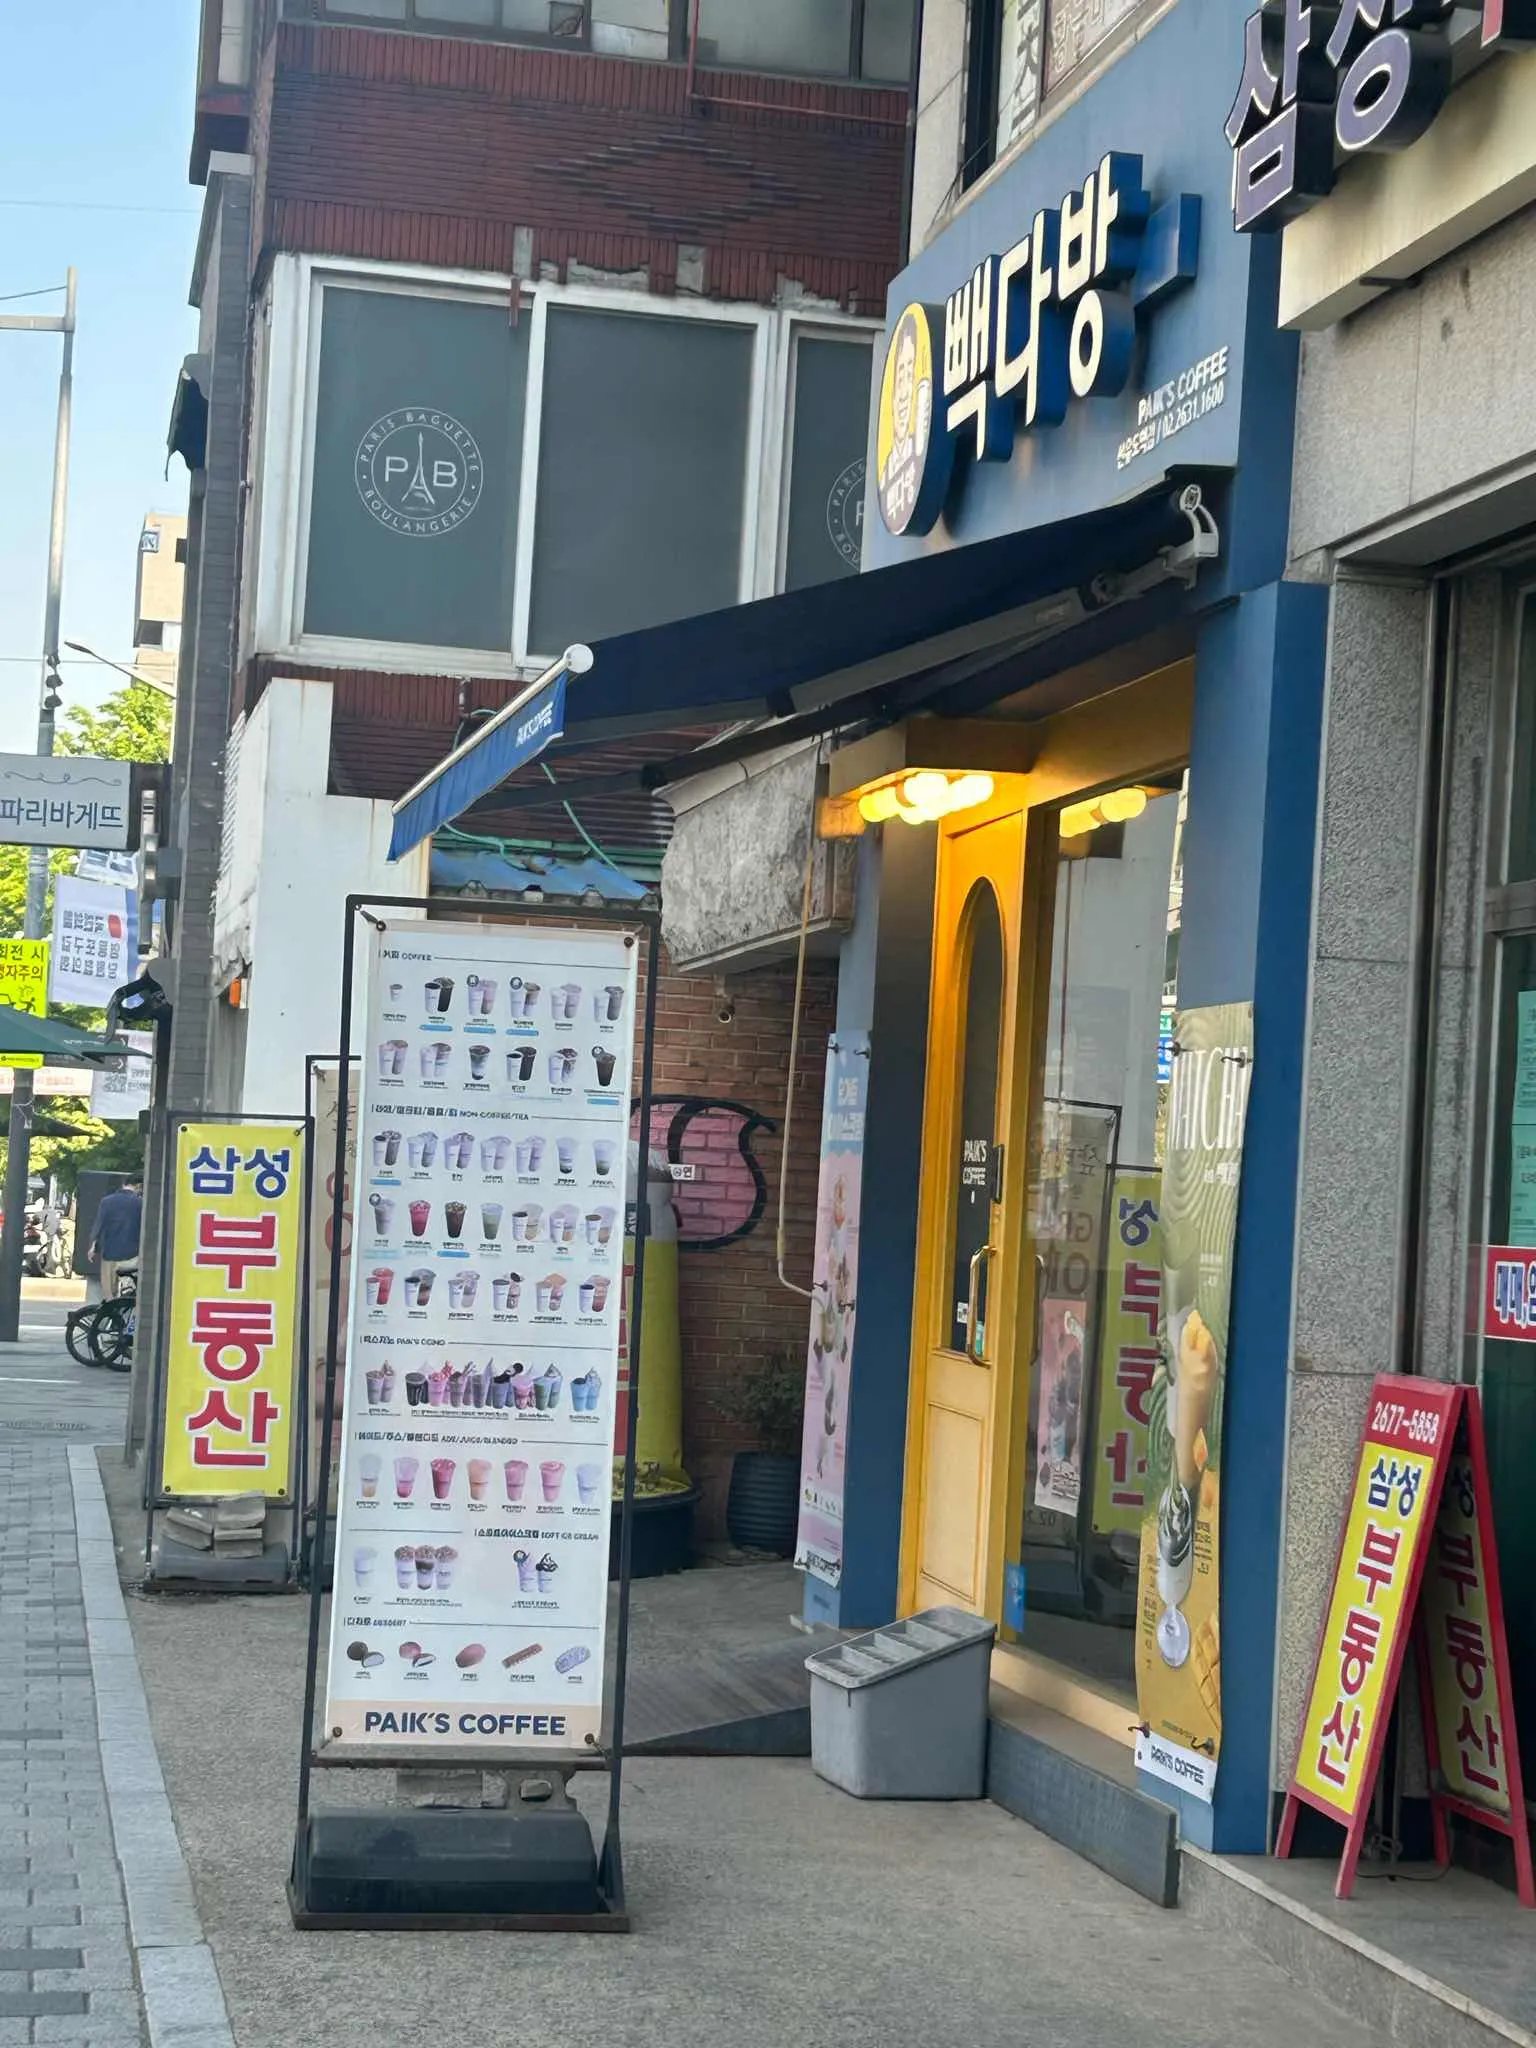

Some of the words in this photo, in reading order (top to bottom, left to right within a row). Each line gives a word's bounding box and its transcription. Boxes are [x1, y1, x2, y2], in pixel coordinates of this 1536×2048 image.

[943, 153, 1118, 462] 빽다방
[1137, 380, 1176, 426] PAIK'S
[1177, 345, 1229, 400] COFFEE
[360, 418, 396, 463] PARIS
[404, 411, 480, 472] BAGUETTE
[364, 489, 473, 533] BOULANGERIE
[0, 797, 123, 830] 파리바게뜨
[31, 944, 45, 963] 시
[188, 1146, 290, 1199] 삼성
[186, 1212, 279, 1468] 부동산
[1371, 1400, 1440, 1444] 2677-5858
[1367, 1457, 1422, 1517] 삼성
[1317, 1523, 1401, 1787] 부동산
[1438, 1530, 1501, 1793] 부동산
[365, 1711, 450, 1734] PAIK'S
[458, 1713, 567, 1737] COFFEE
